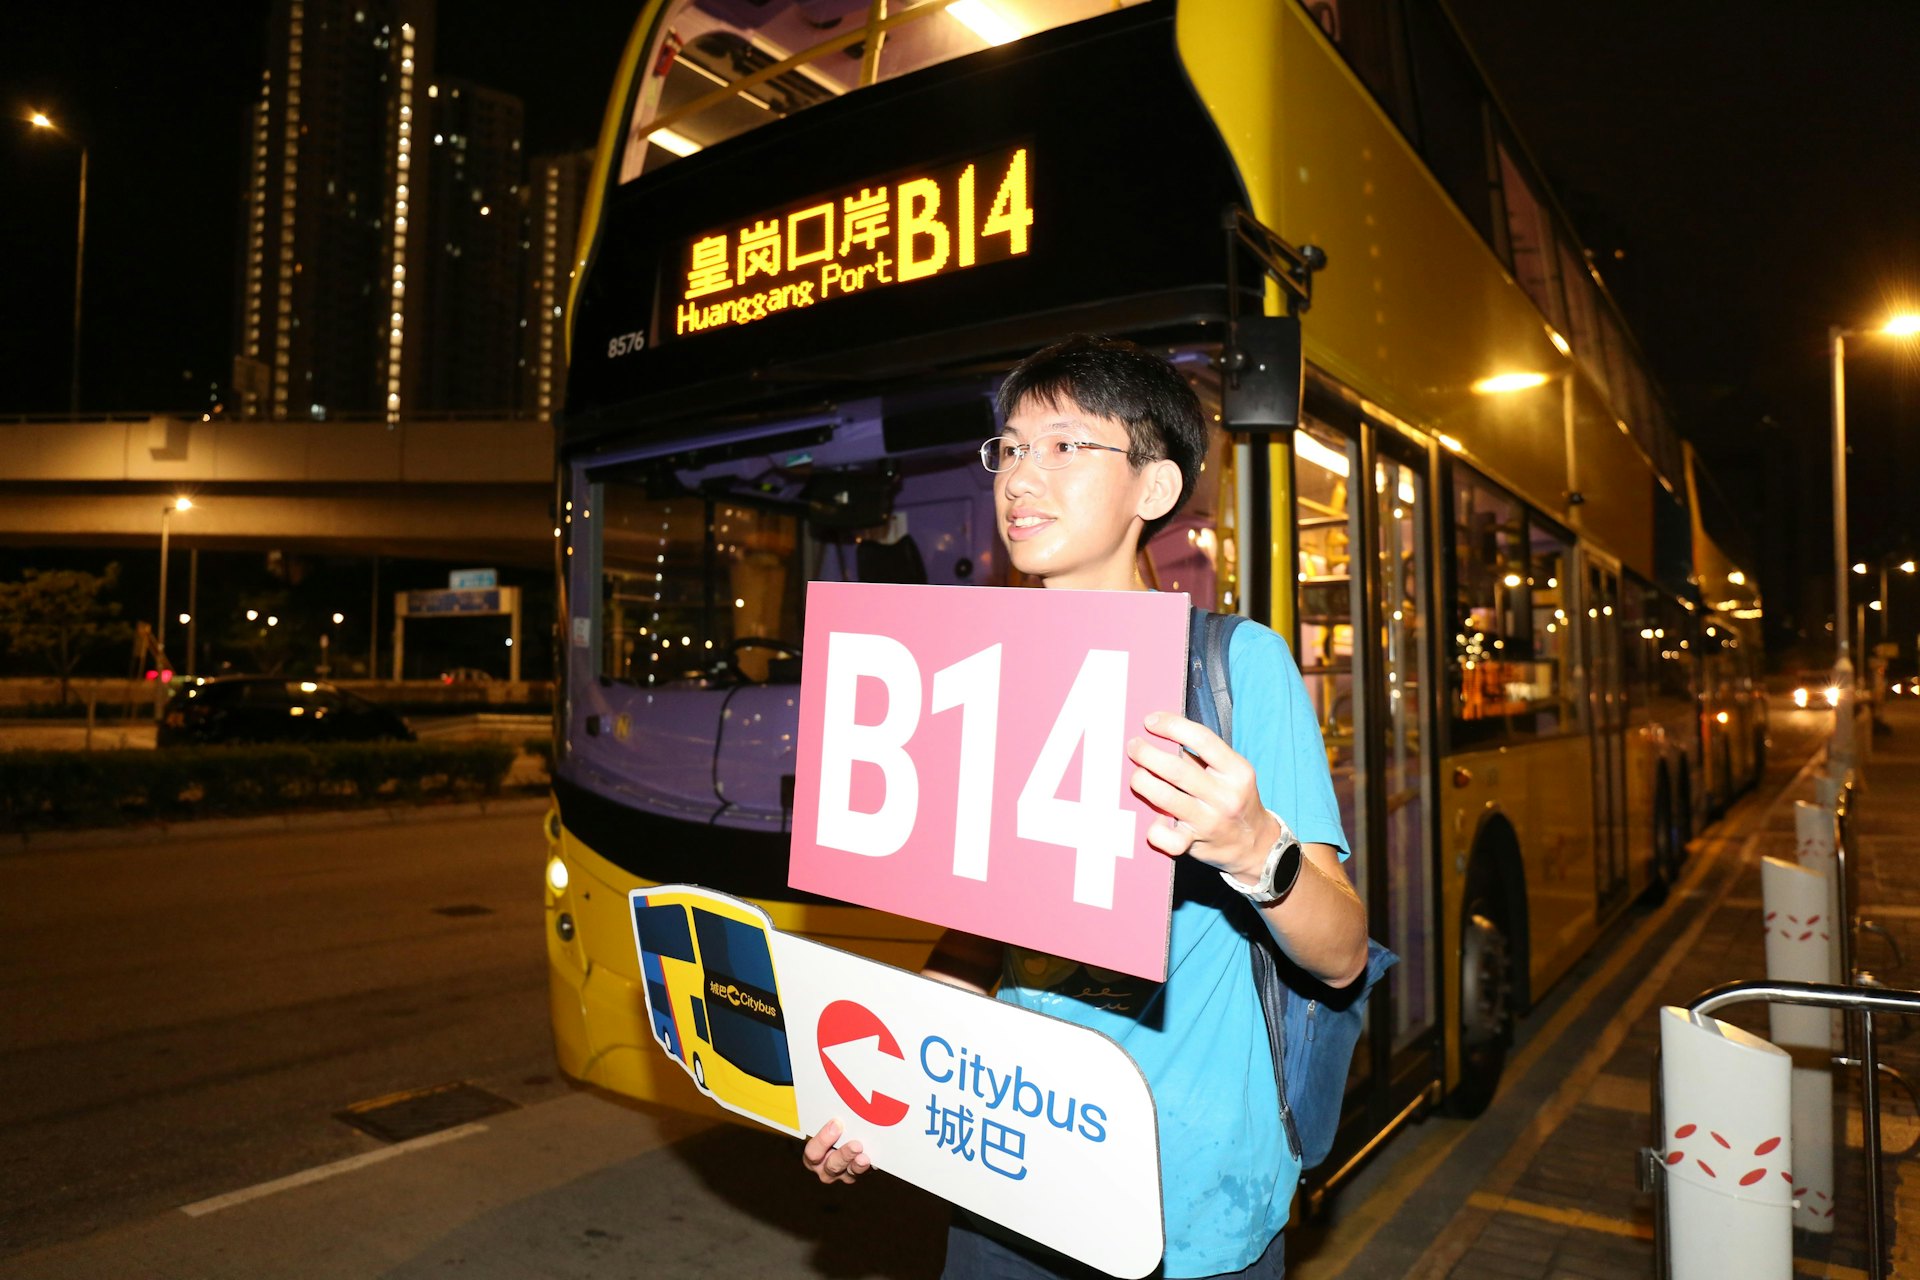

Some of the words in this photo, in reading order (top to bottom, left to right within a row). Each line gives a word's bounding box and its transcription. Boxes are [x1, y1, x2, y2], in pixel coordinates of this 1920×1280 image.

[897, 148, 1034, 283] B14
[676, 281, 815, 336] Huanggang
[820, 250, 894, 299] Port
[608, 330, 644, 358] 8576
[815, 631, 1137, 911] B14
[740, 992, 777, 1017] Citybus
[919, 1035, 1109, 1145] Citybus
[925, 1093, 1030, 1182] 城巴
